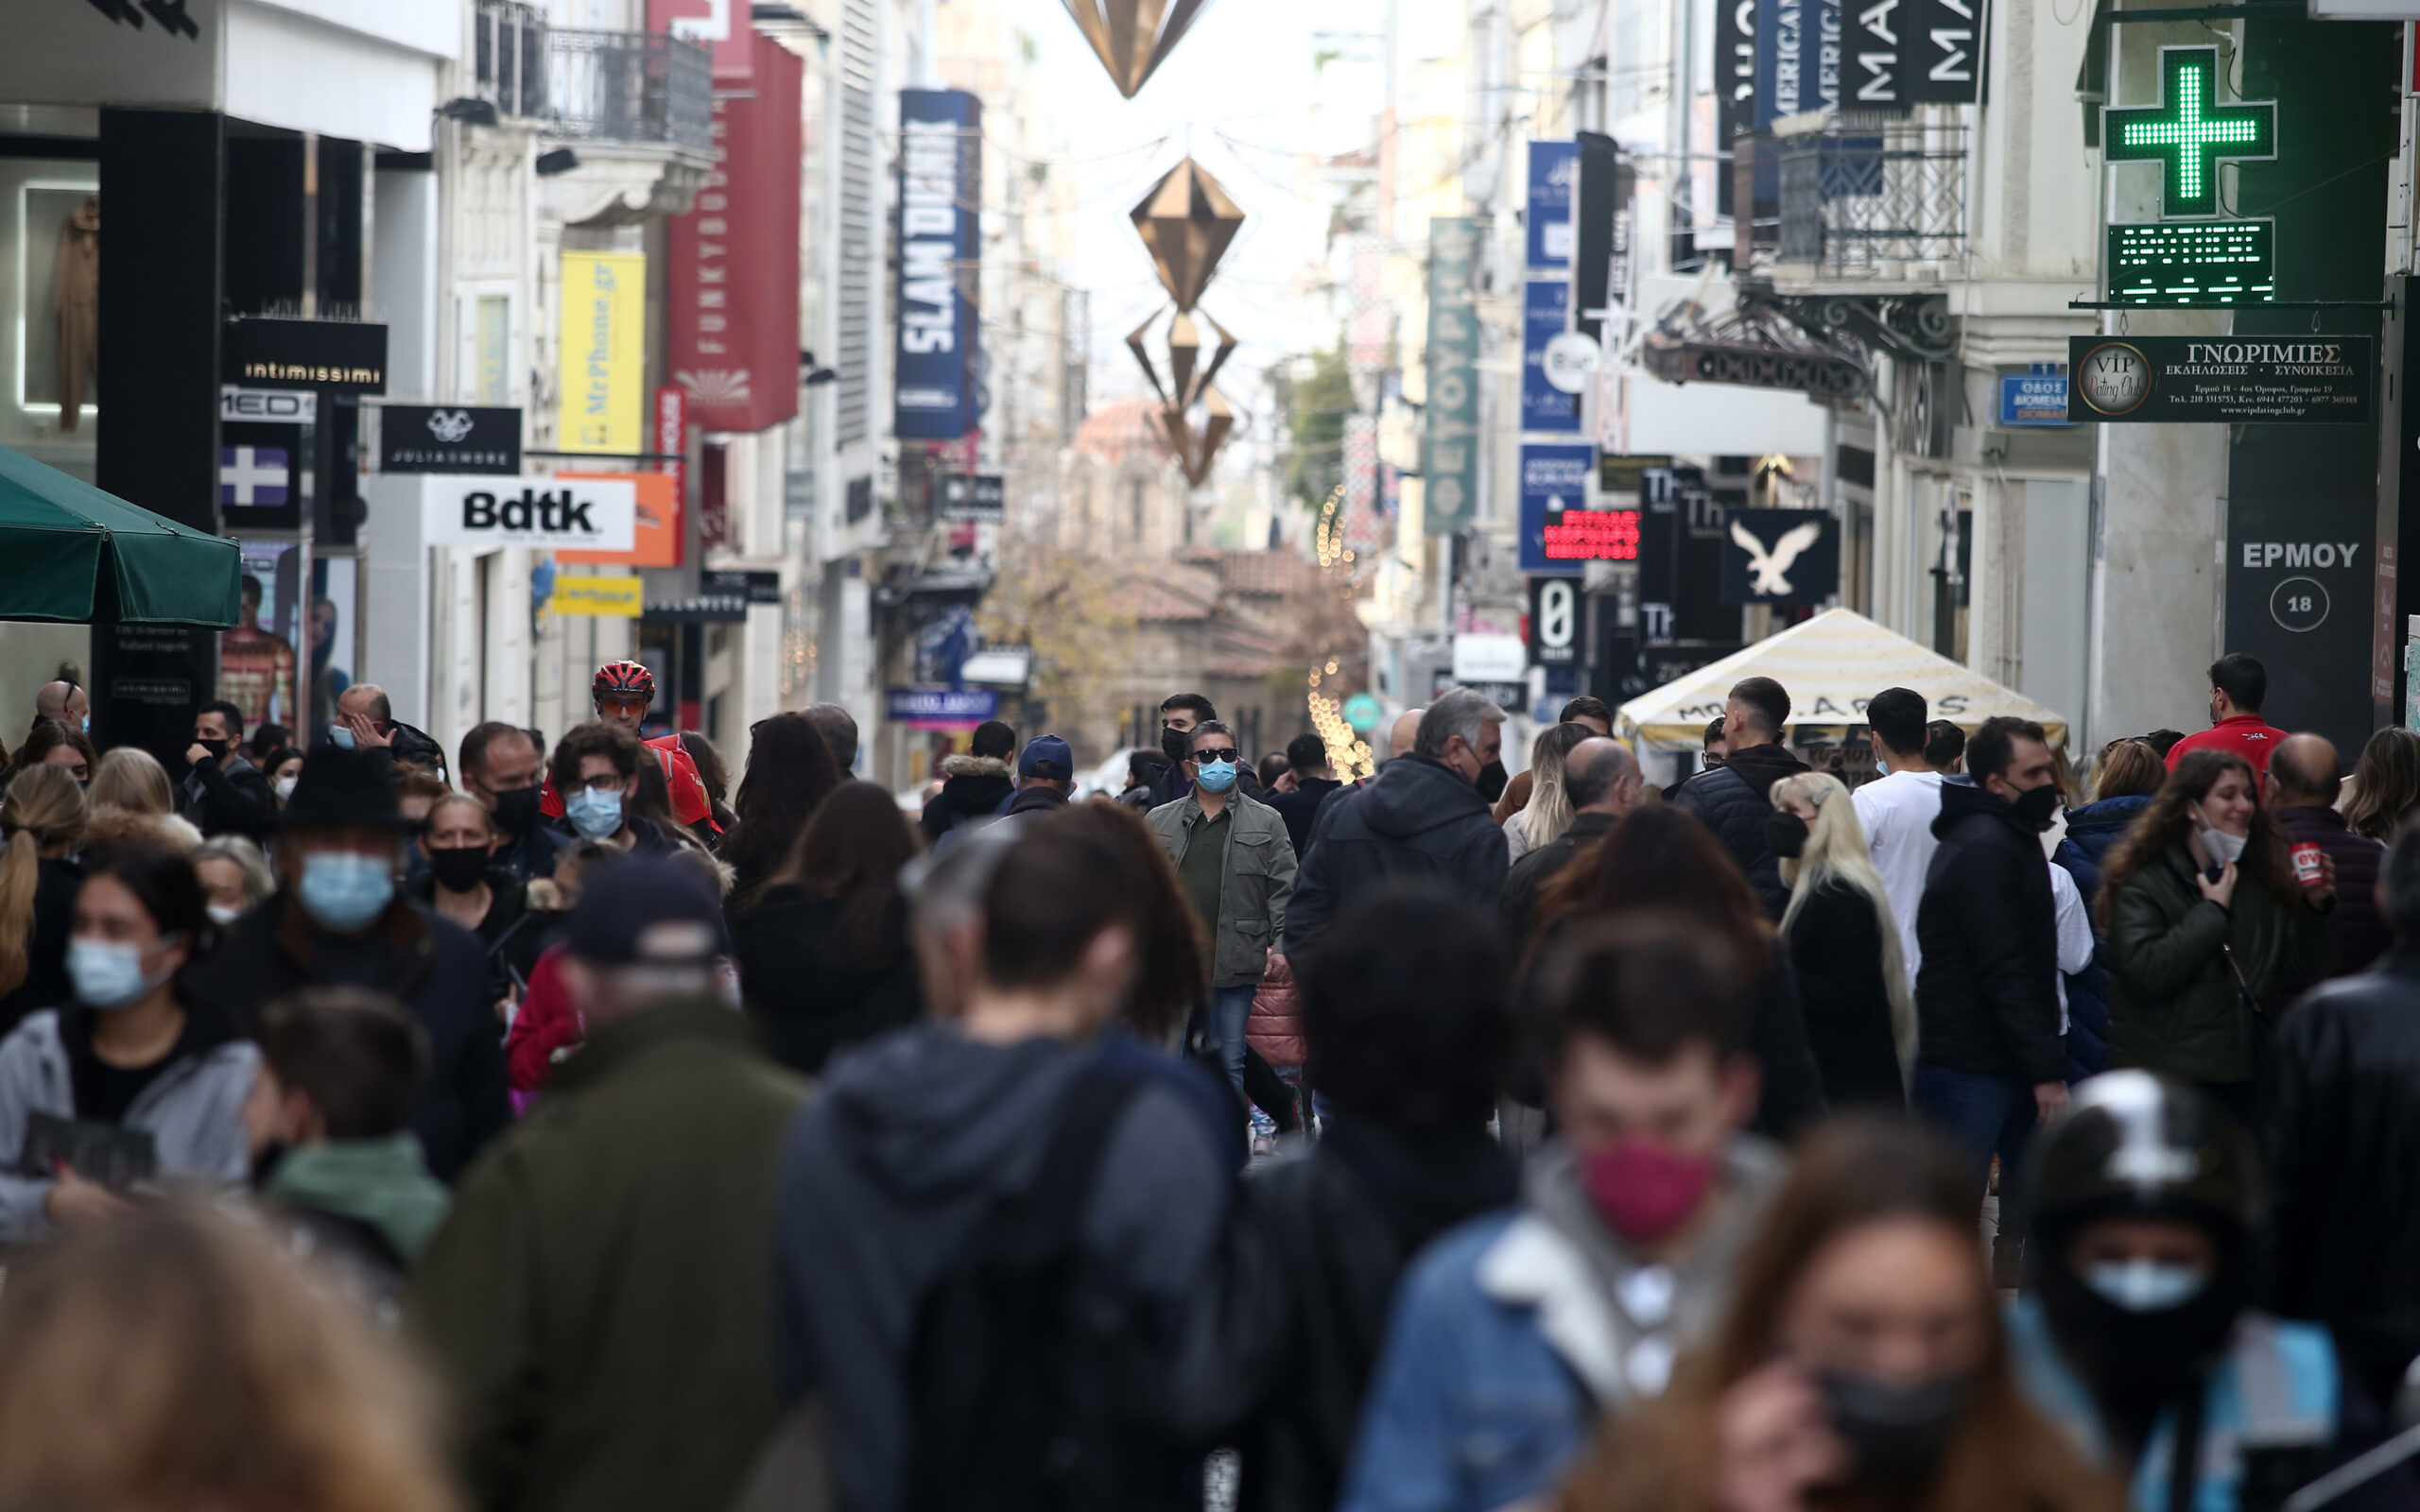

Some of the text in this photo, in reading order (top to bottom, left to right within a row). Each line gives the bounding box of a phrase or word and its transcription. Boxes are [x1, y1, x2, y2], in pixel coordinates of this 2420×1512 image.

[903, 241, 956, 352] SLAM
[2187, 343, 2342, 364] ΓΝΩΡΙΜΙΕΣ
[245, 362, 380, 384] intimissimi
[2166, 365, 2355, 376] ΕΚΔΗΛΩΣΕΙΣ ΣΥΝΟΙΚΕΣΙΑ
[2021, 381, 2064, 394] ΟΔΟΣ
[2324, 385, 2333, 393] 19
[2189, 395, 2204, 404] 210
[2256, 395, 2274, 404] 6944
[2277, 395, 2303, 404] 477203
[2311, 395, 2329, 404] 6977
[2221, 405, 2307, 417] www.vipdatingclub.gr
[2287, 595, 2312, 612] 18
